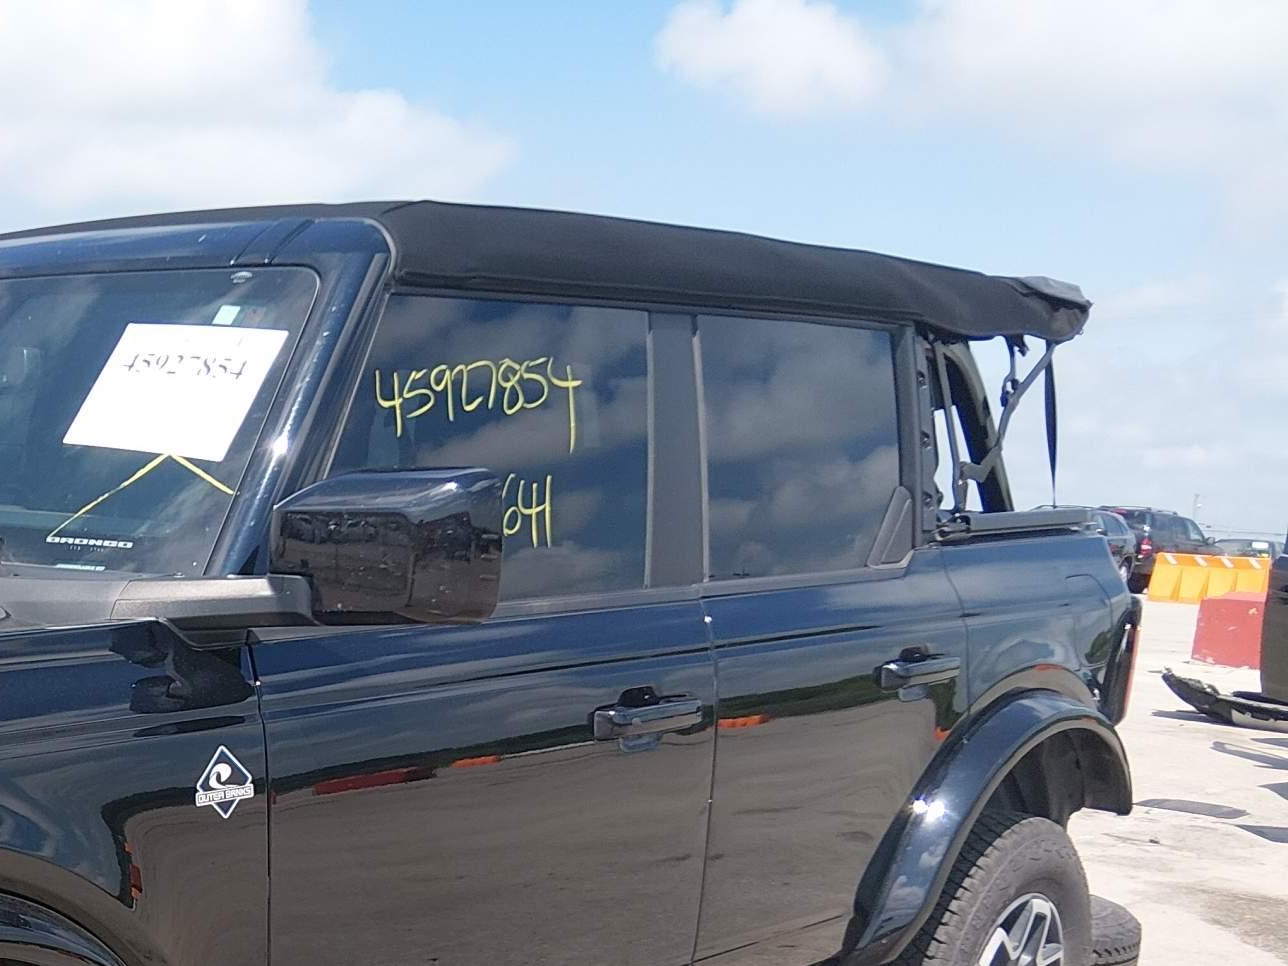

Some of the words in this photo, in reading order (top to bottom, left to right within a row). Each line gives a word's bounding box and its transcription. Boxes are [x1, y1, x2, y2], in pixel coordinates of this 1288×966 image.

[375, 356, 583, 454] 45927854
[198, 791, 225, 804] OUTER
[225, 786, 252, 799] BANKS
